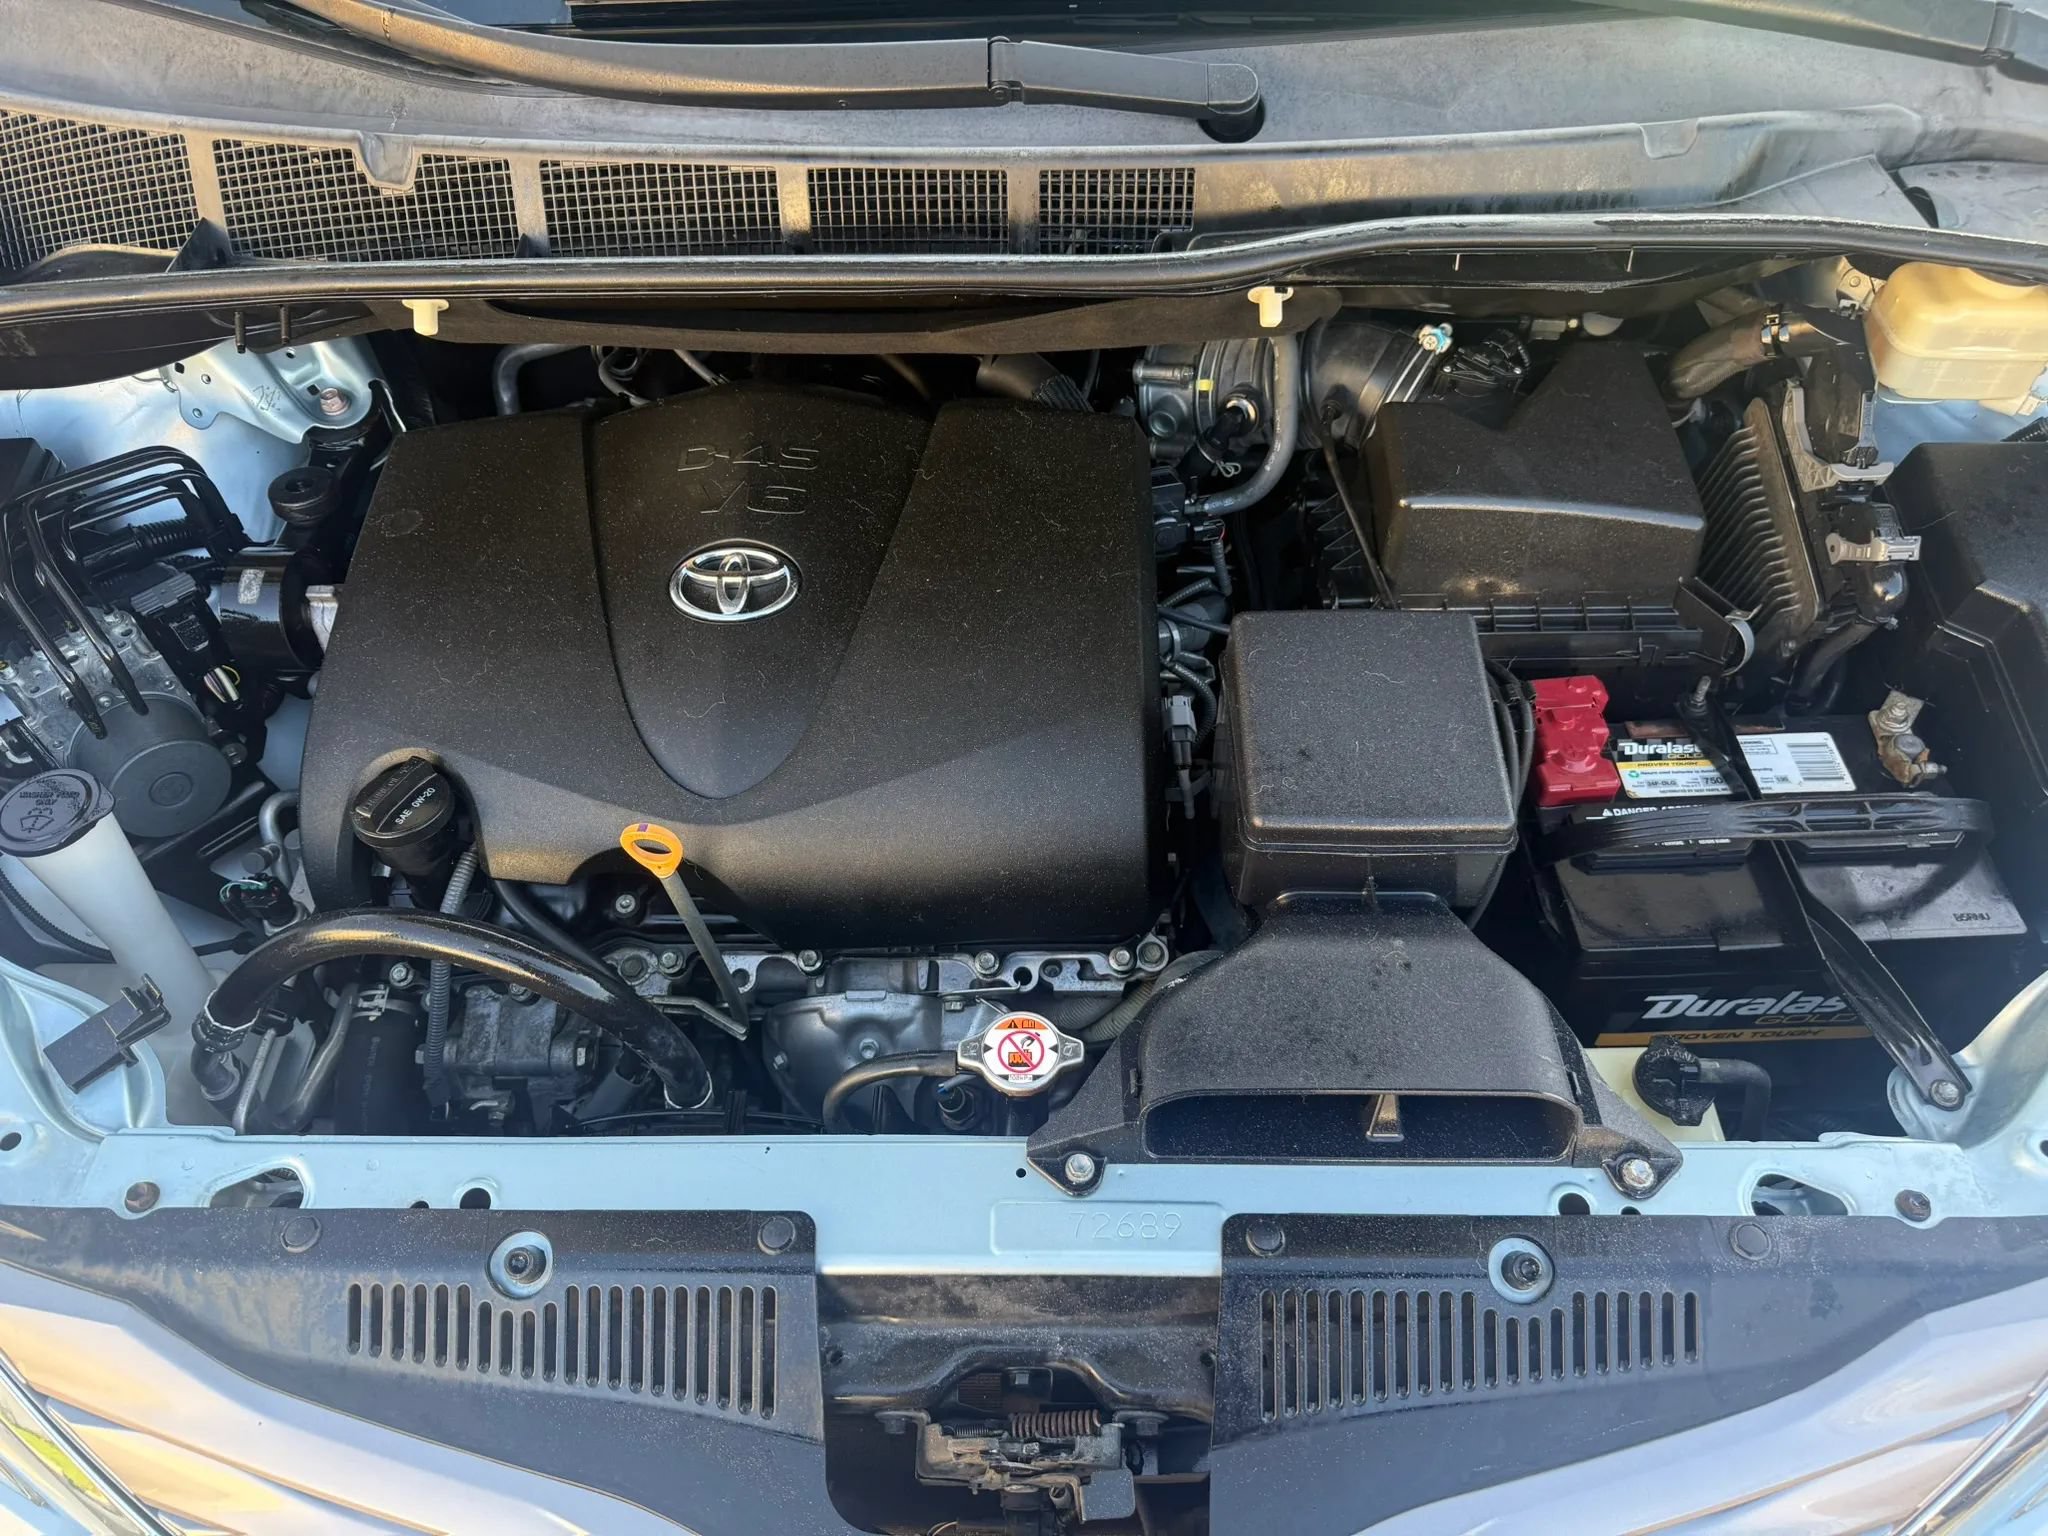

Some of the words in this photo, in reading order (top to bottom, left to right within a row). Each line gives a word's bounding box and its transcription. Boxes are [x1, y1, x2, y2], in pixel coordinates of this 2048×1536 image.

[1704, 776, 1723, 784] 750
[395, 809, 413, 825] SAE
[1641, 991, 1848, 1019] Duralas
[1664, 1030, 1744, 1040] ROVEN
[1750, 1029, 1825, 1039] TOUGH
[1068, 1211, 1182, 1240] 72689
